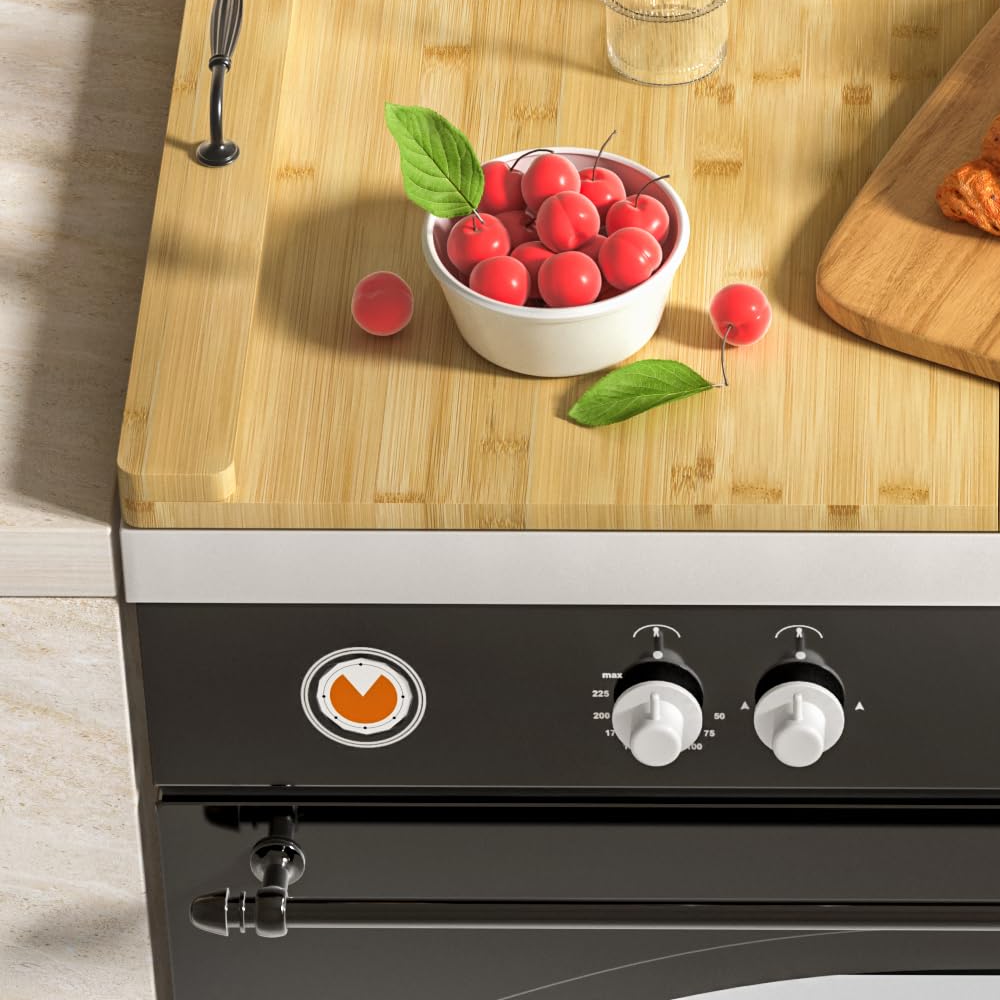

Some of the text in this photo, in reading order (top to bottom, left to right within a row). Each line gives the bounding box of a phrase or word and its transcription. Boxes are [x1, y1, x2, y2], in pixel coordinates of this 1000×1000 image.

[592, 690, 610, 698] 225
[593, 712, 611, 720] 200
[714, 712, 726, 720] 50
[605, 729, 615, 737] 17
[703, 729, 716, 737] 75
